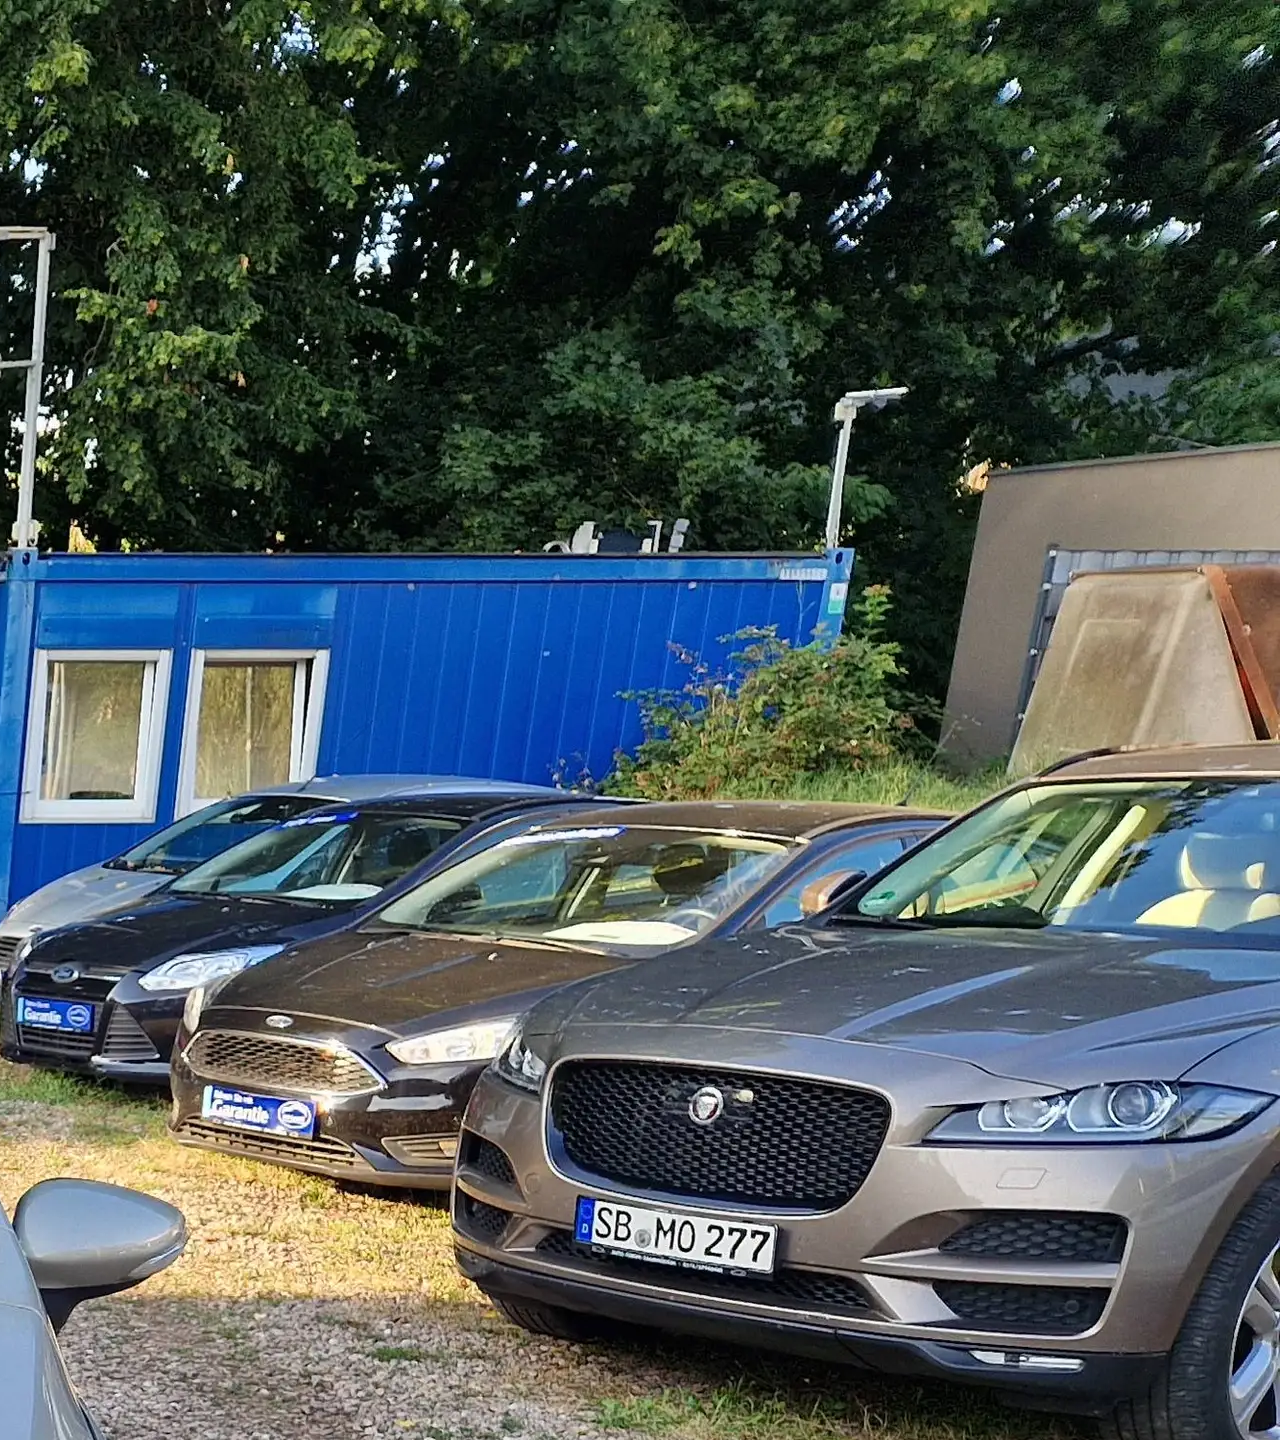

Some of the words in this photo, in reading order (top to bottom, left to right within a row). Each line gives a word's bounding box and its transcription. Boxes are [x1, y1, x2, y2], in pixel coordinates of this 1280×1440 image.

[581, 1223, 589, 1234] D
[595, 1207, 632, 1241] SB
[654, 1217, 696, 1253] MO
[704, 1224, 771, 1263] 277
